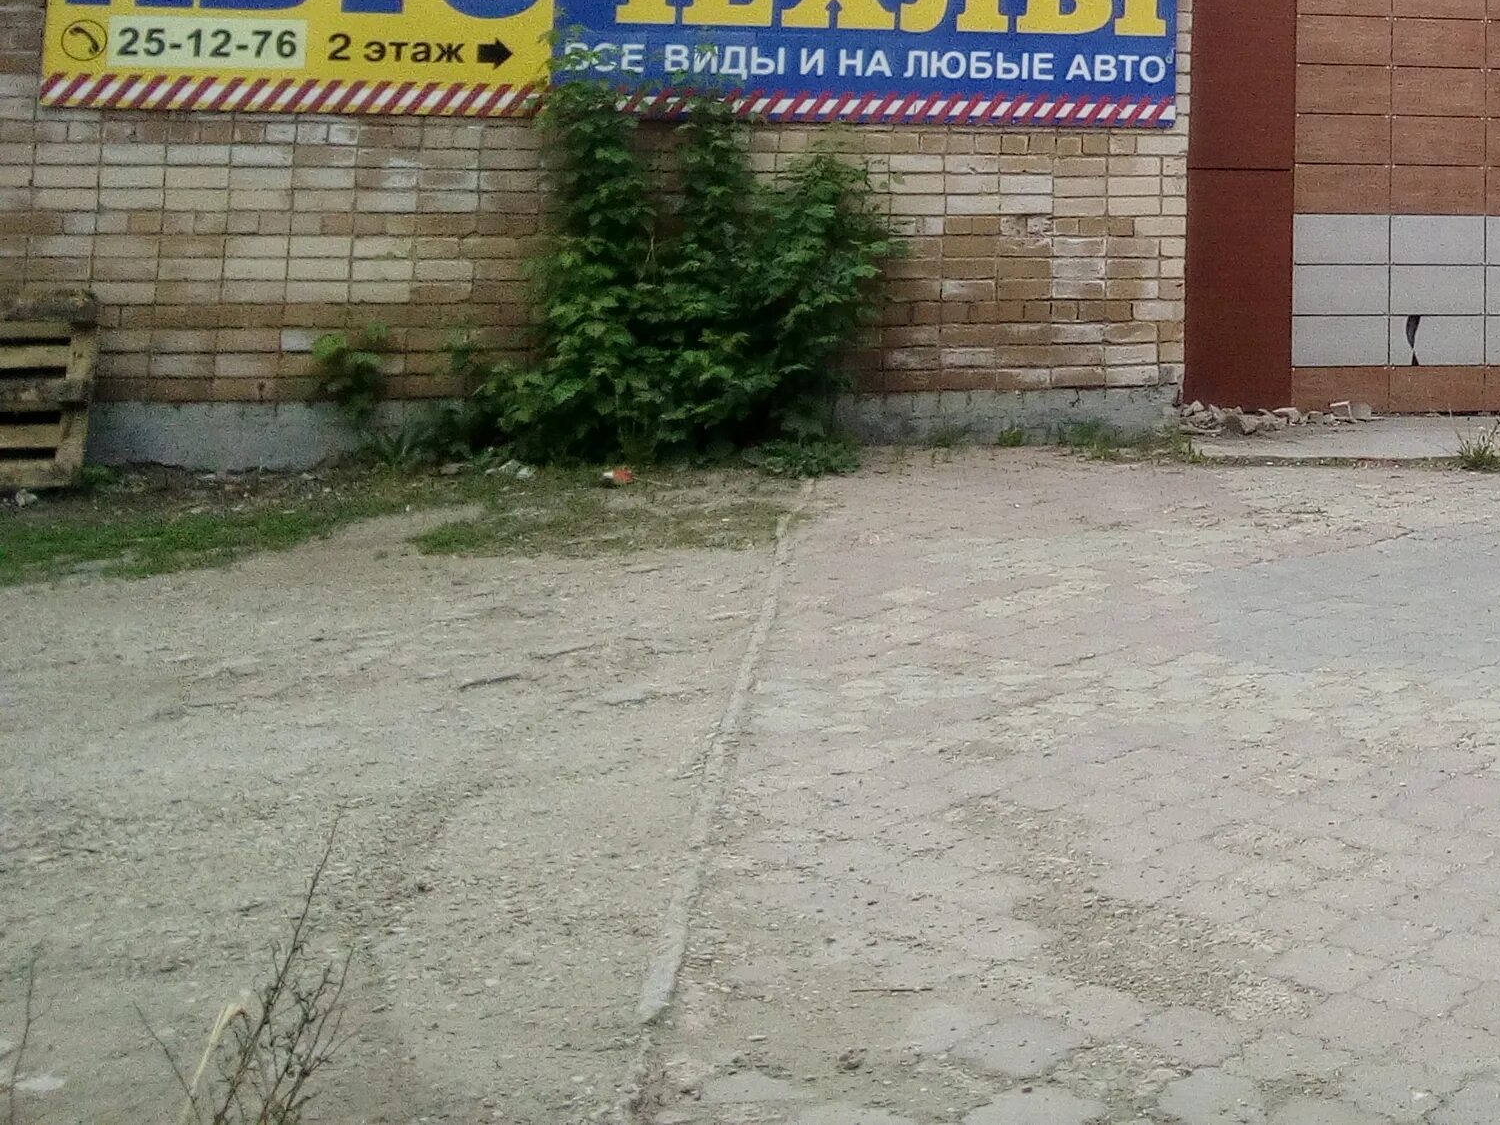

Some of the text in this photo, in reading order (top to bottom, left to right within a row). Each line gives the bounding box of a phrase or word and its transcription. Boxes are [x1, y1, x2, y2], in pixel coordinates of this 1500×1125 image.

[117, 27, 464, 63] 25-12-76 2 этаж
[664, 43, 785, 81] ВИДЫ
[801, 48, 824, 75] И
[840, 49, 892, 77] НА
[903, 49, 1055, 81] ЛЮБЫЕ
[1066, 53, 1166, 84] АВТО
